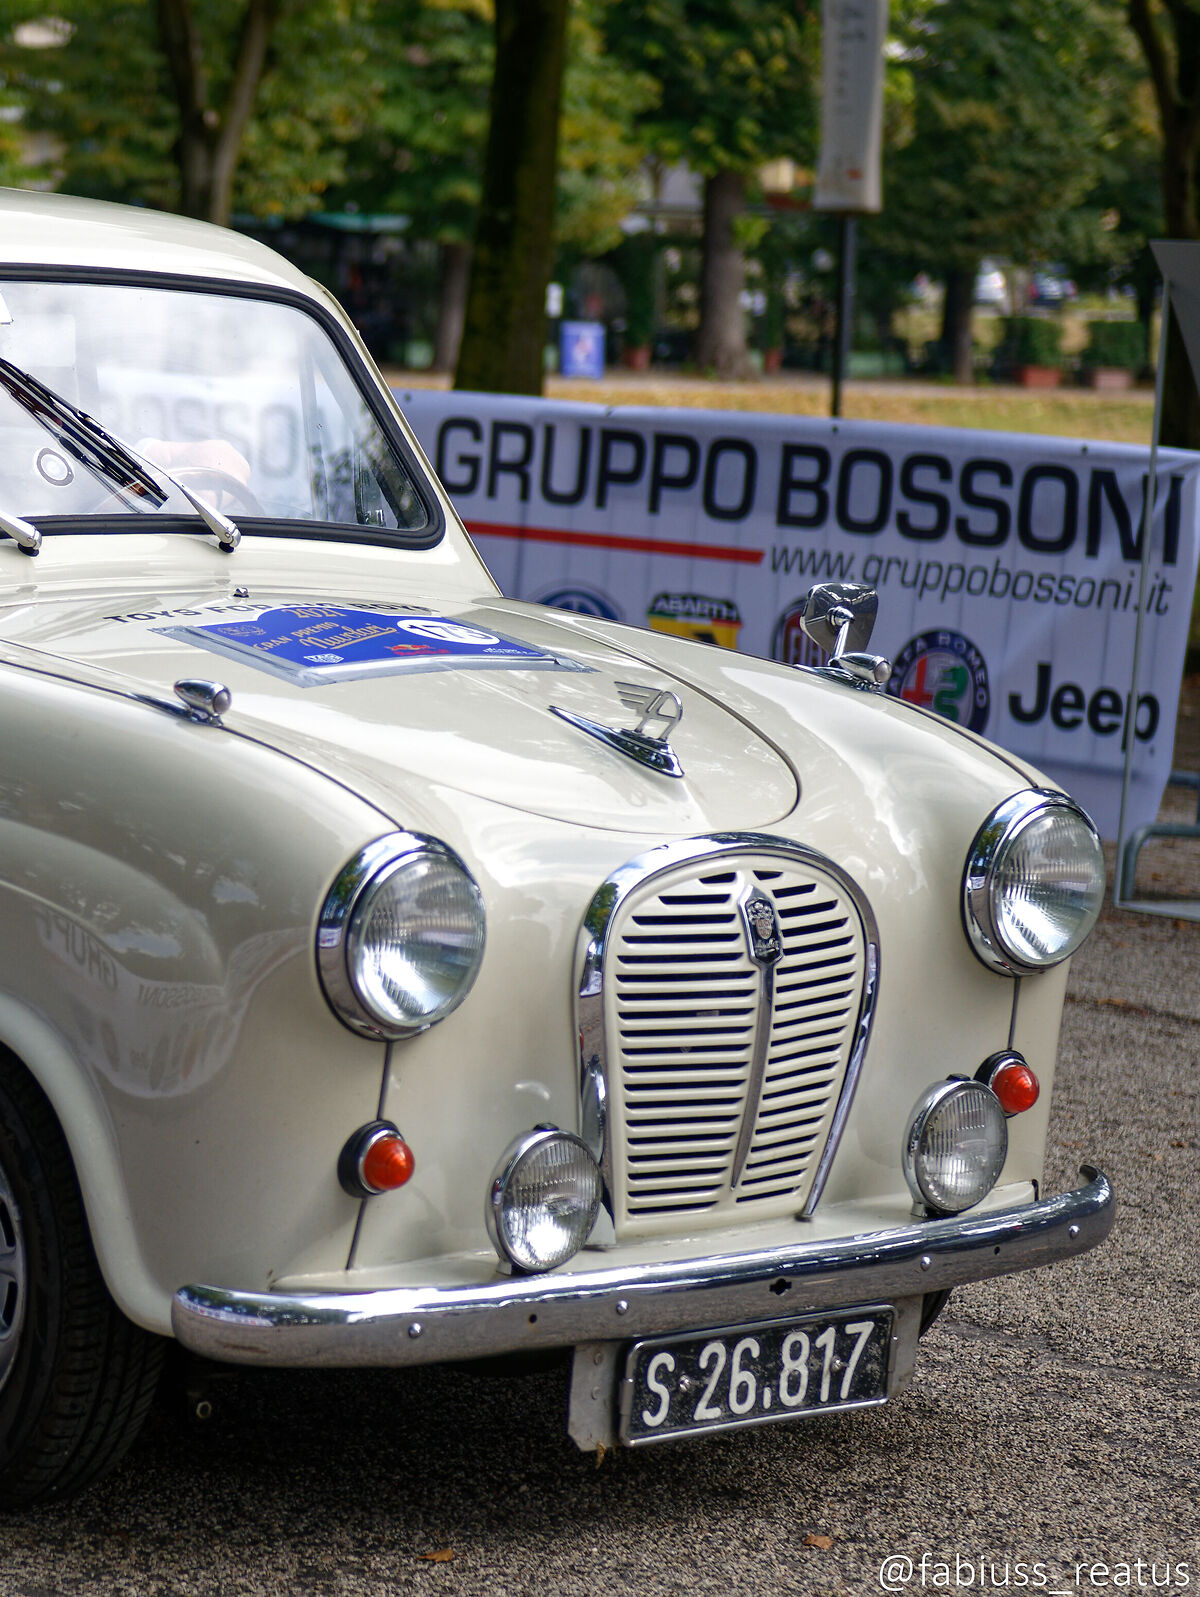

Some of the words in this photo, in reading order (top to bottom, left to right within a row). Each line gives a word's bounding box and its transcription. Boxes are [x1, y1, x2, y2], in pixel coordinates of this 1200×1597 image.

[437, 417, 760, 522] GRUPPO
[775, 444, 1185, 566] BOSSONI
[103, 608, 202, 623] TOYS
[653, 596, 739, 621] ABARTH
[771, 545, 1173, 616] www.gruppobossoni.it
[291, 622, 341, 636] PREMIO
[938, 632, 987, 708] ROMEO
[1009, 663, 1161, 752] Jeep
[641, 1351, 676, 1428] S
[692, 1321, 876, 1422] 26.817
